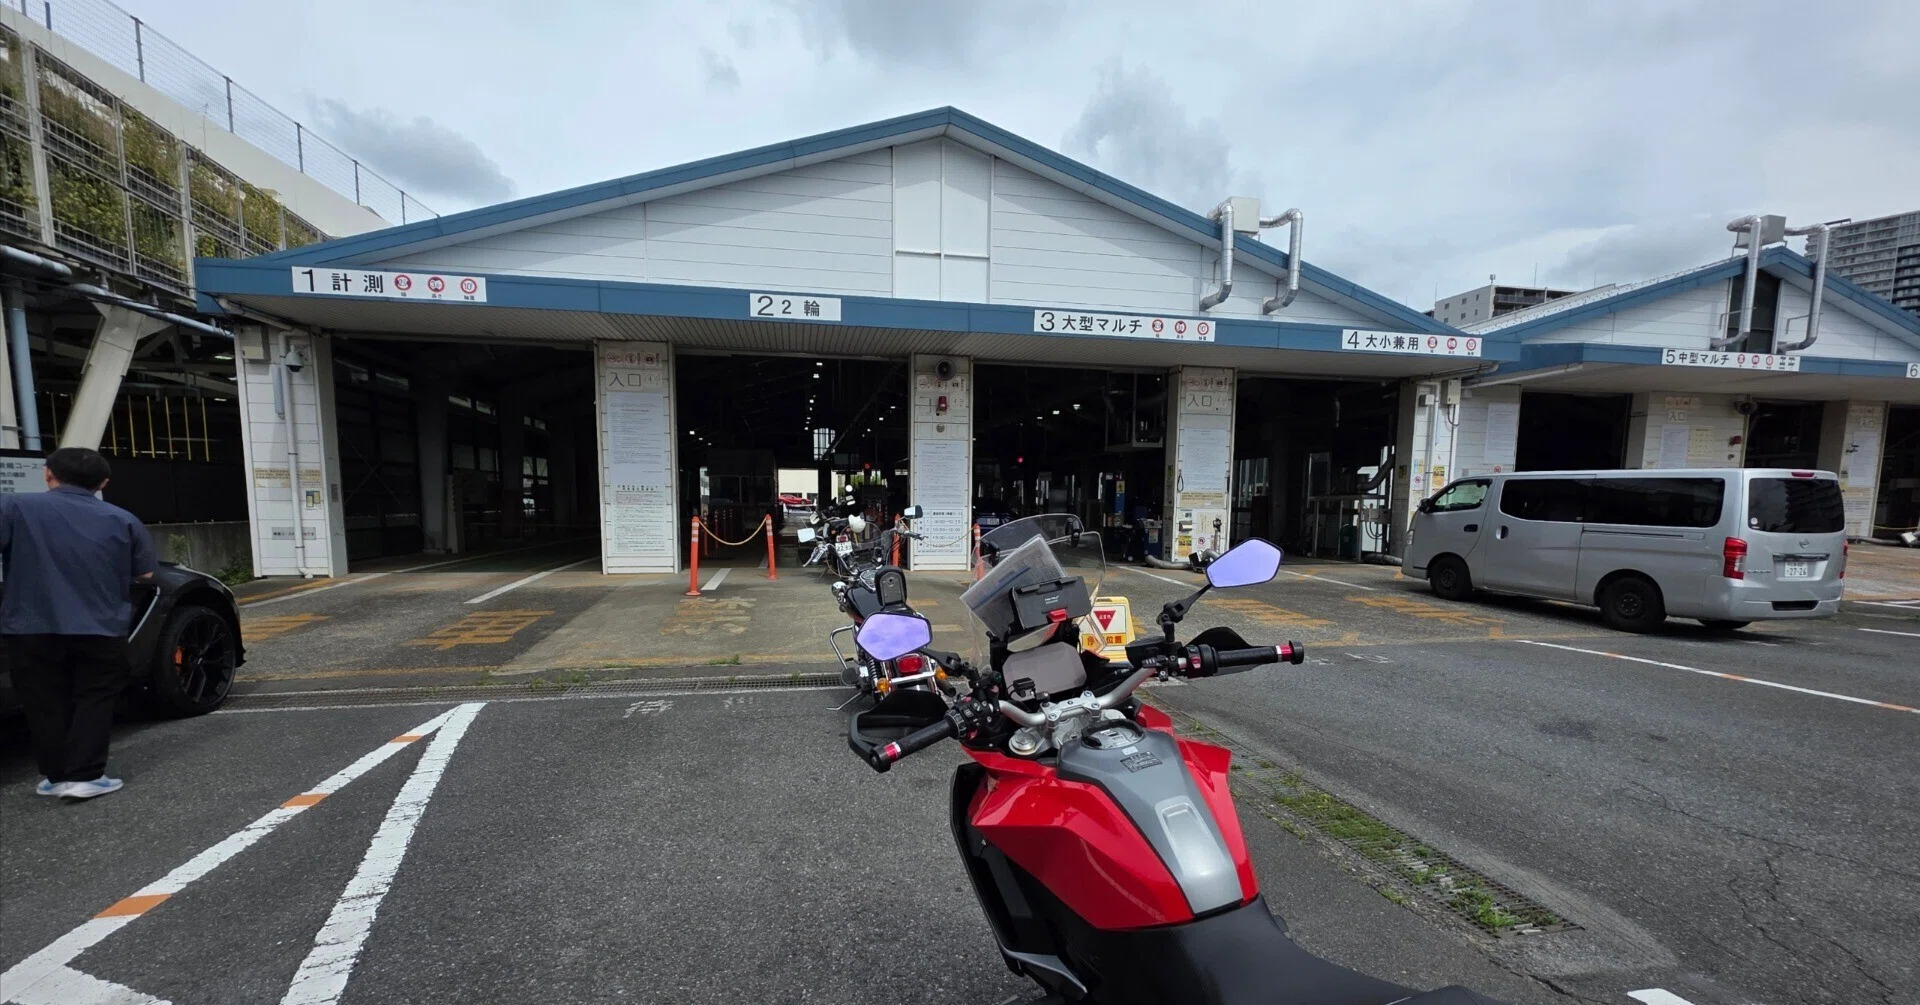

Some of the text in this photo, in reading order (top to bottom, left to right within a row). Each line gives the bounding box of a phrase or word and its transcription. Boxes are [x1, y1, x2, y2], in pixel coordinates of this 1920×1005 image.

[331, 272, 384, 294] 計測
[1061, 314, 1143, 334] 大型マルチ
[1365, 333, 1419, 351] 大小兼用
[1678, 351, 1730, 366] 中型マルチ
[1909, 363, 1919, 377] 6
[608, 371, 642, 387] 入口
[1187, 393, 1212, 407] 入口
